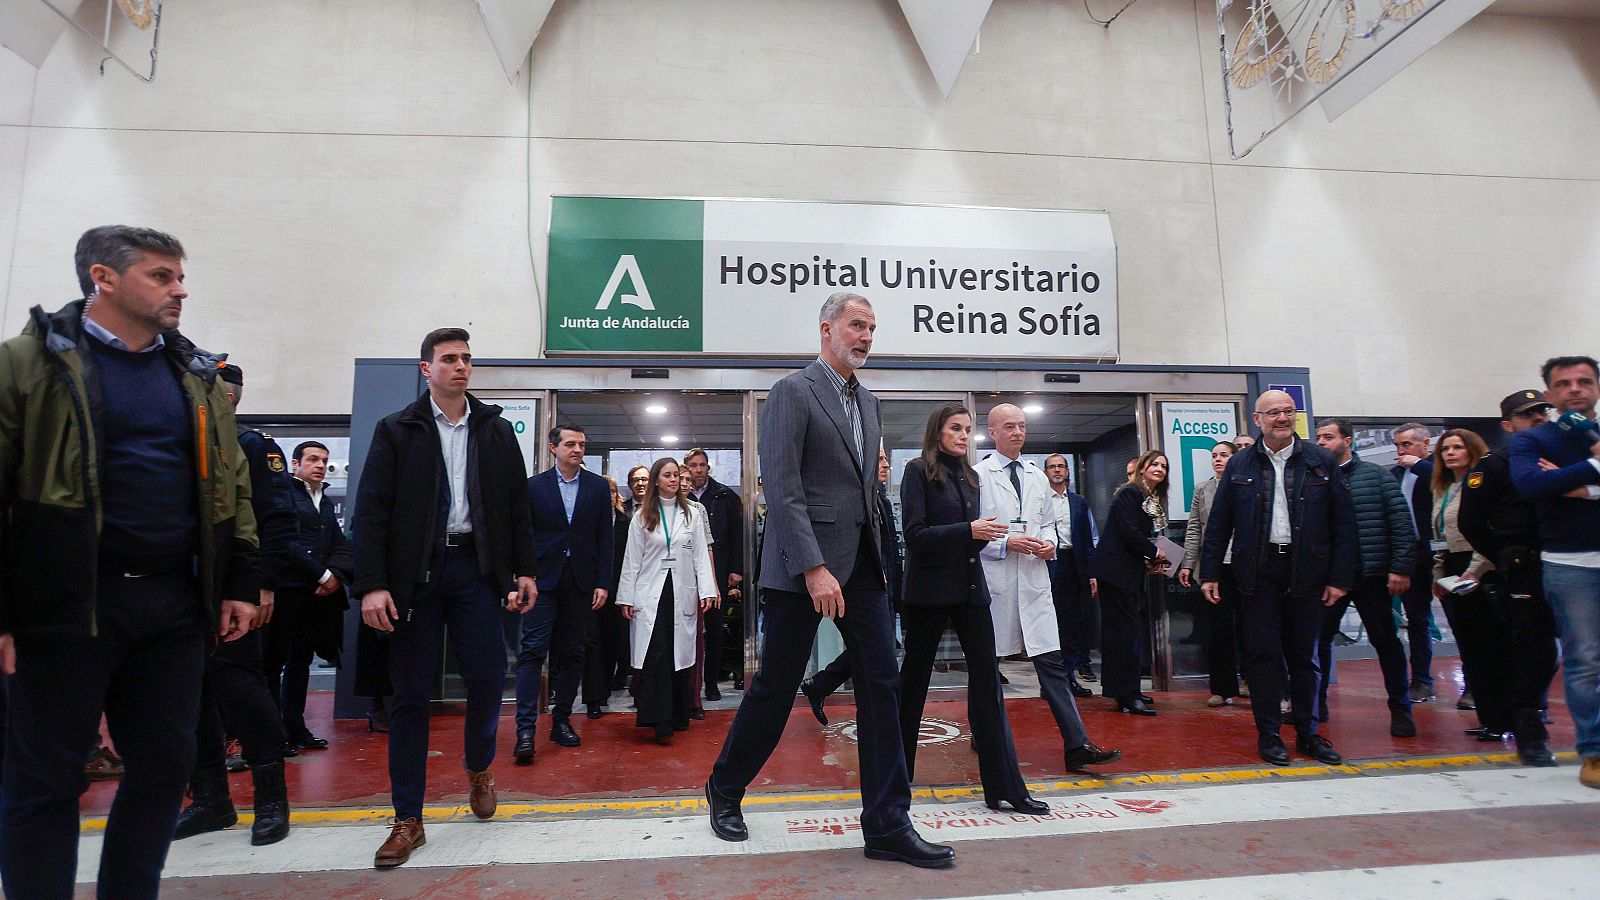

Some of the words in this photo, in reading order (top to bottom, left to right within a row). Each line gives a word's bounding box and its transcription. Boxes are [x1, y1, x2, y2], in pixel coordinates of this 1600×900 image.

[719, 255, 869, 293] Hospital
[881, 258, 1101, 294] Universitario
[560, 316, 599, 329] Junta
[602, 316, 620, 329] de
[622, 315, 690, 329] Andalucía
[913, 303, 1007, 334] Reina
[1018, 302, 1101, 336] Sofía
[1172, 418, 1228, 434] Acceso
[1010, 808, 1119, 824] Regala
